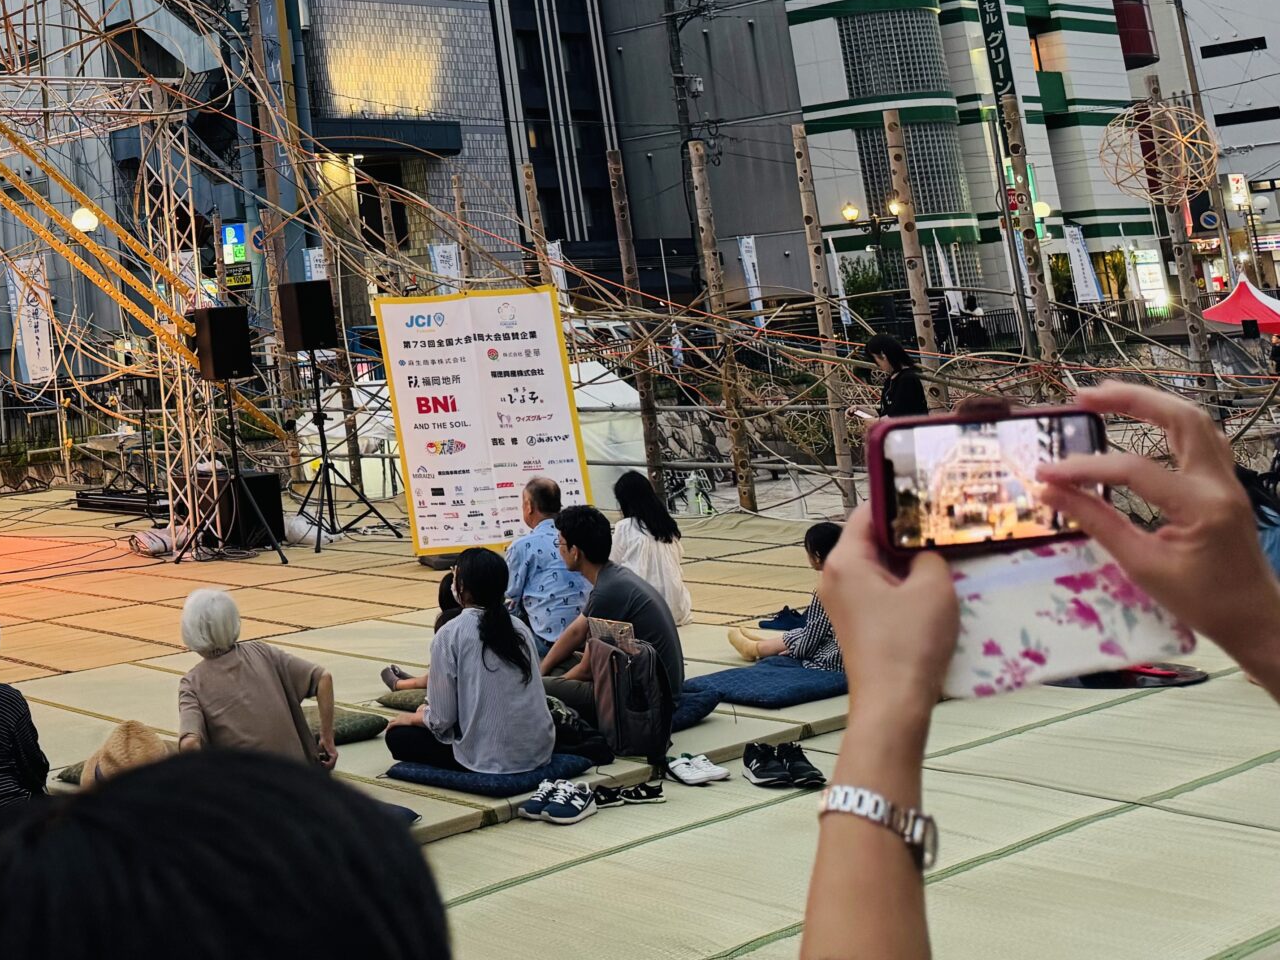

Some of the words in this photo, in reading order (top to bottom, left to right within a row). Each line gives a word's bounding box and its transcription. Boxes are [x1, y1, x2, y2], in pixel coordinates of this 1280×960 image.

[405, 315, 431, 328] JCI
[422, 374, 461, 386] 福岡地所
[432, 422, 447, 430] THE
